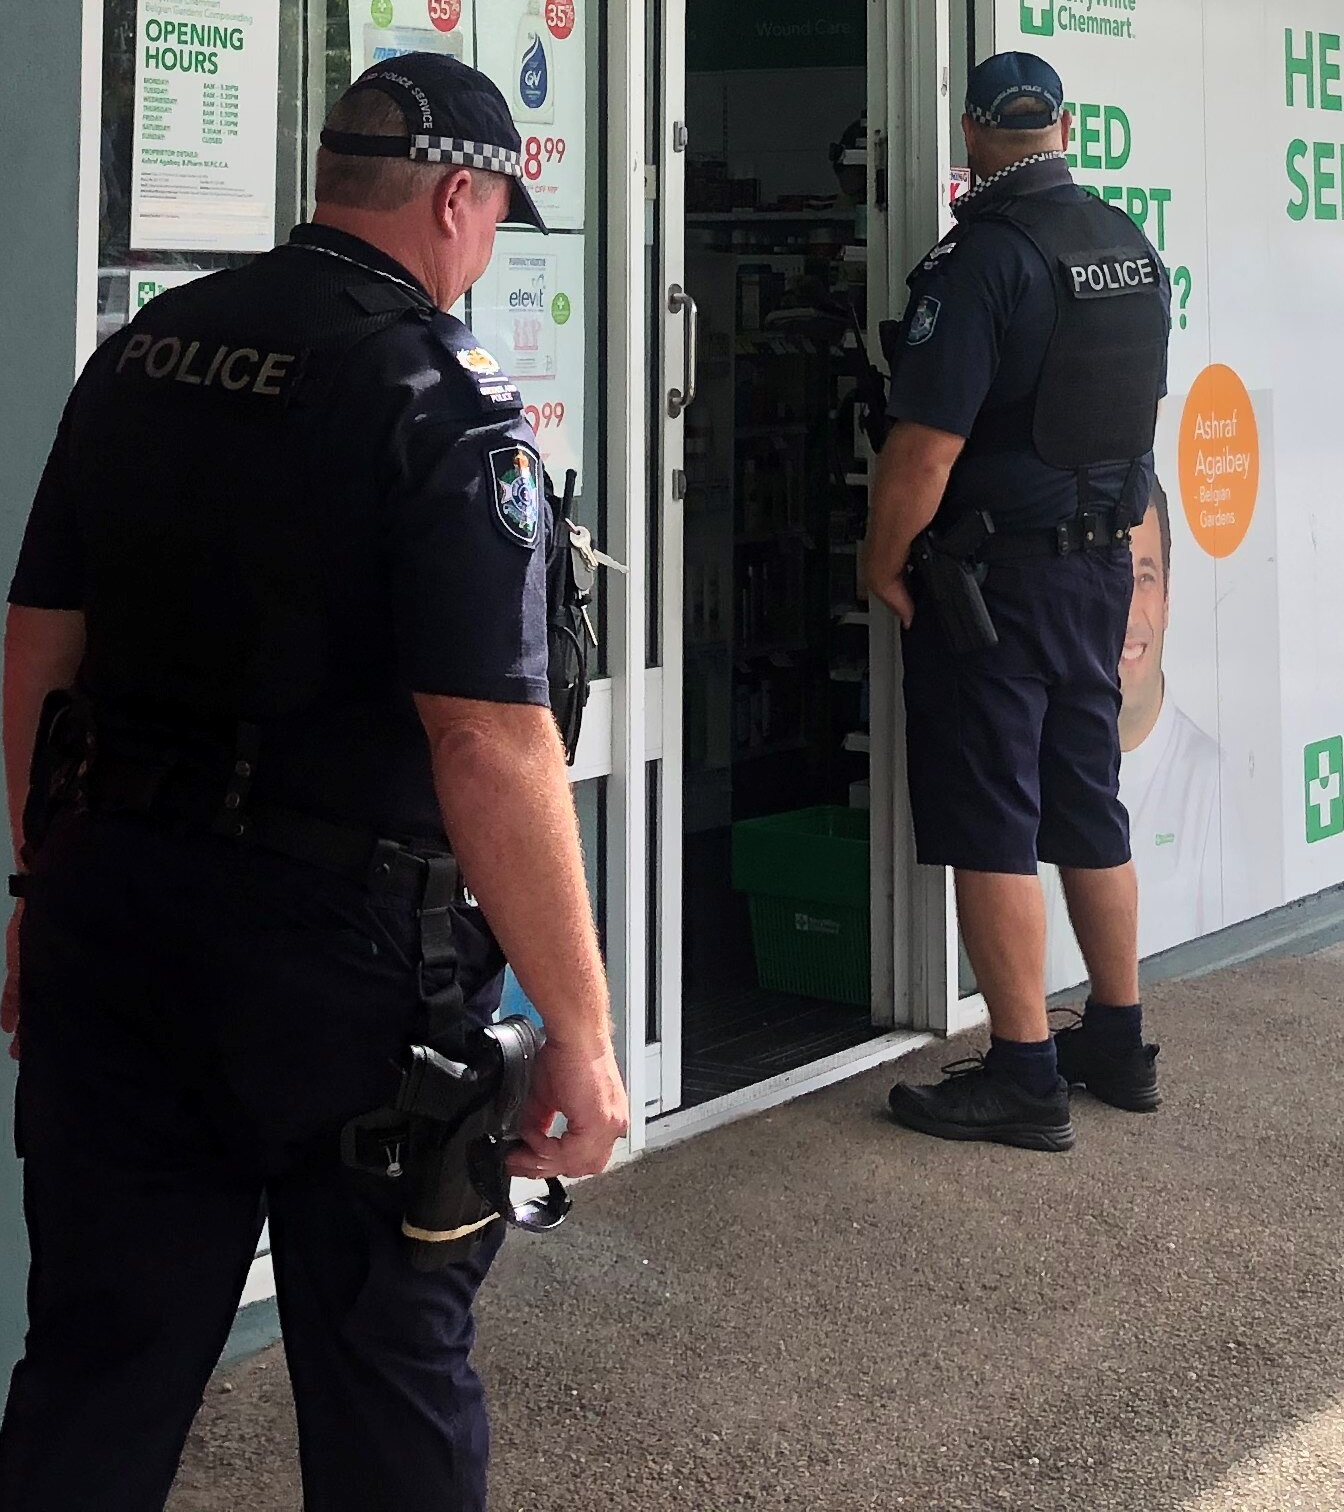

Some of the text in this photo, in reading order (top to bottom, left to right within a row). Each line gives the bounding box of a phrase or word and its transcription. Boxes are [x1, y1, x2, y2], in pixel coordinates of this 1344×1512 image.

[145, 18, 244, 51] OPENING
[1057, 5, 1132, 39] Chemmart
[145, 46, 218, 75] HOURS
[411, 87, 433, 129] SERVICE
[1069, 257, 1155, 292] POLICE
[509, 288, 544, 308] elevit
[114, 334, 295, 396] POLICE
[1194, 408, 1238, 440] Ashraf
[1194, 445, 1251, 484] Agaibey
[1199, 483, 1231, 507] Belgian
[1199, 508, 1236, 528] Gardens
